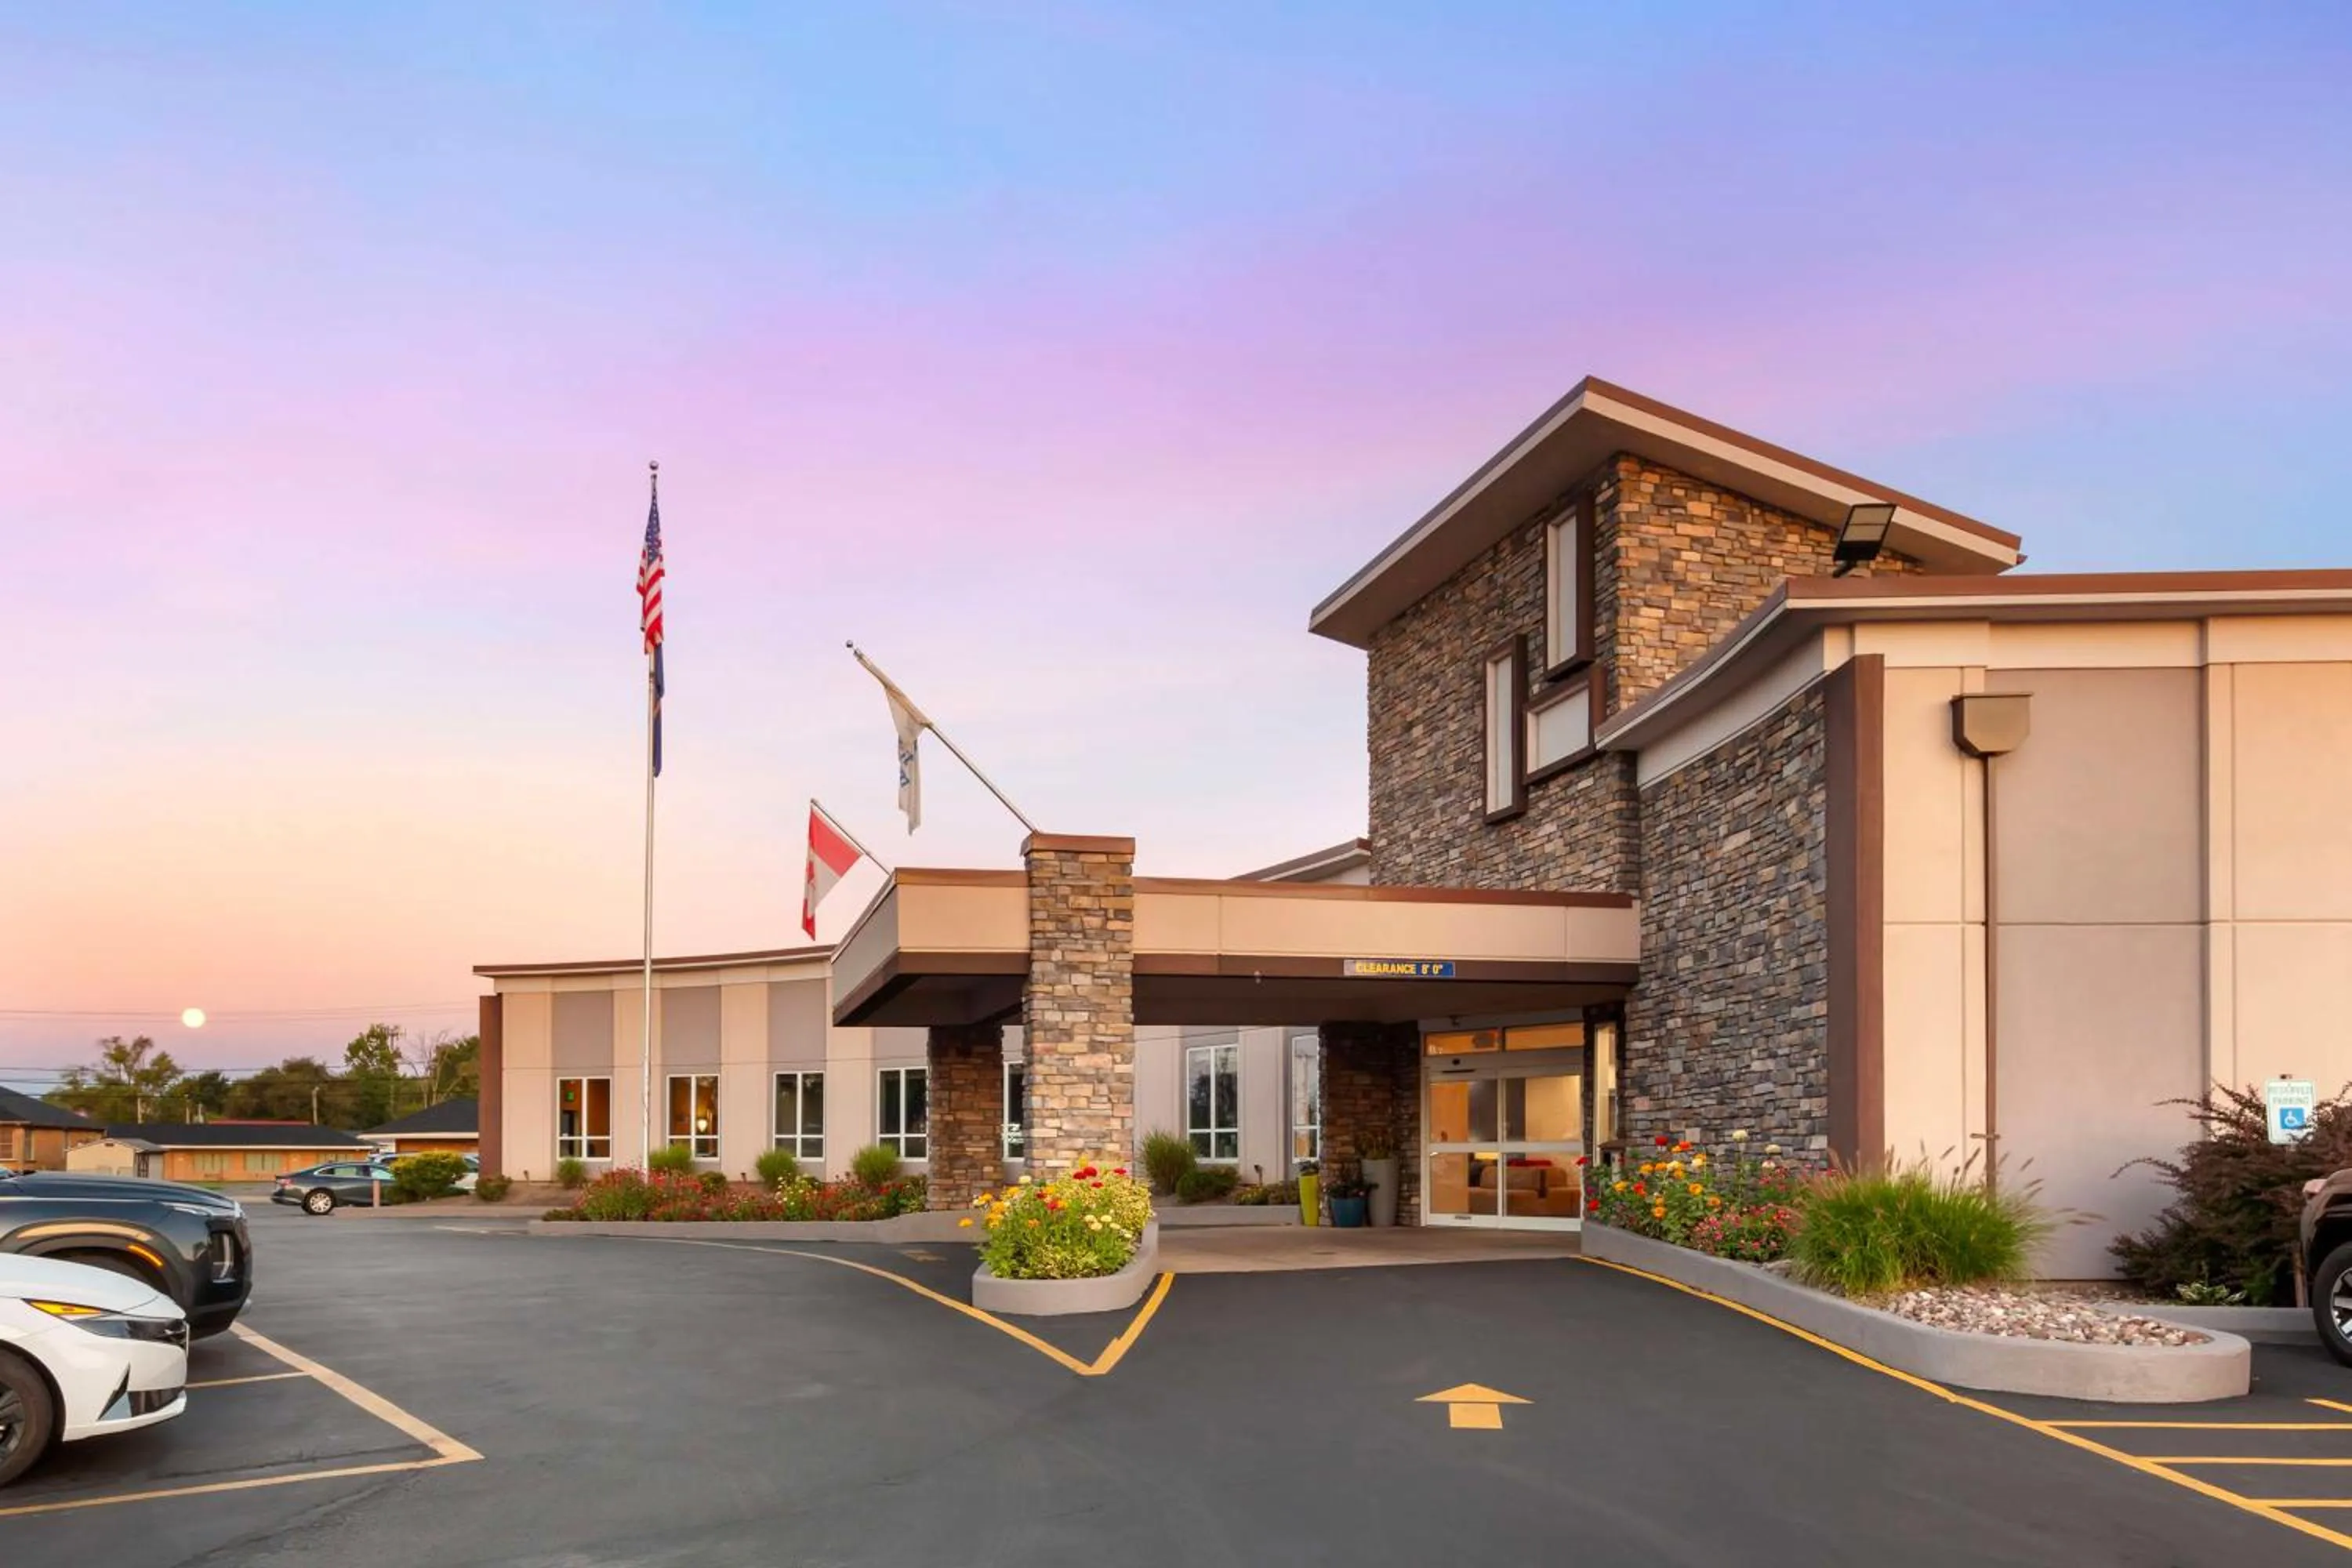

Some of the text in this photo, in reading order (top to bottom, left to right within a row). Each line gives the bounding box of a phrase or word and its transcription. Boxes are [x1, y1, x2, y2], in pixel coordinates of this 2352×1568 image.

[1355, 962, 1417, 975] CLEARANCE
[2268, 1086, 2311, 1094] RESERVED
[2272, 1096, 2310, 1105] PARKING
